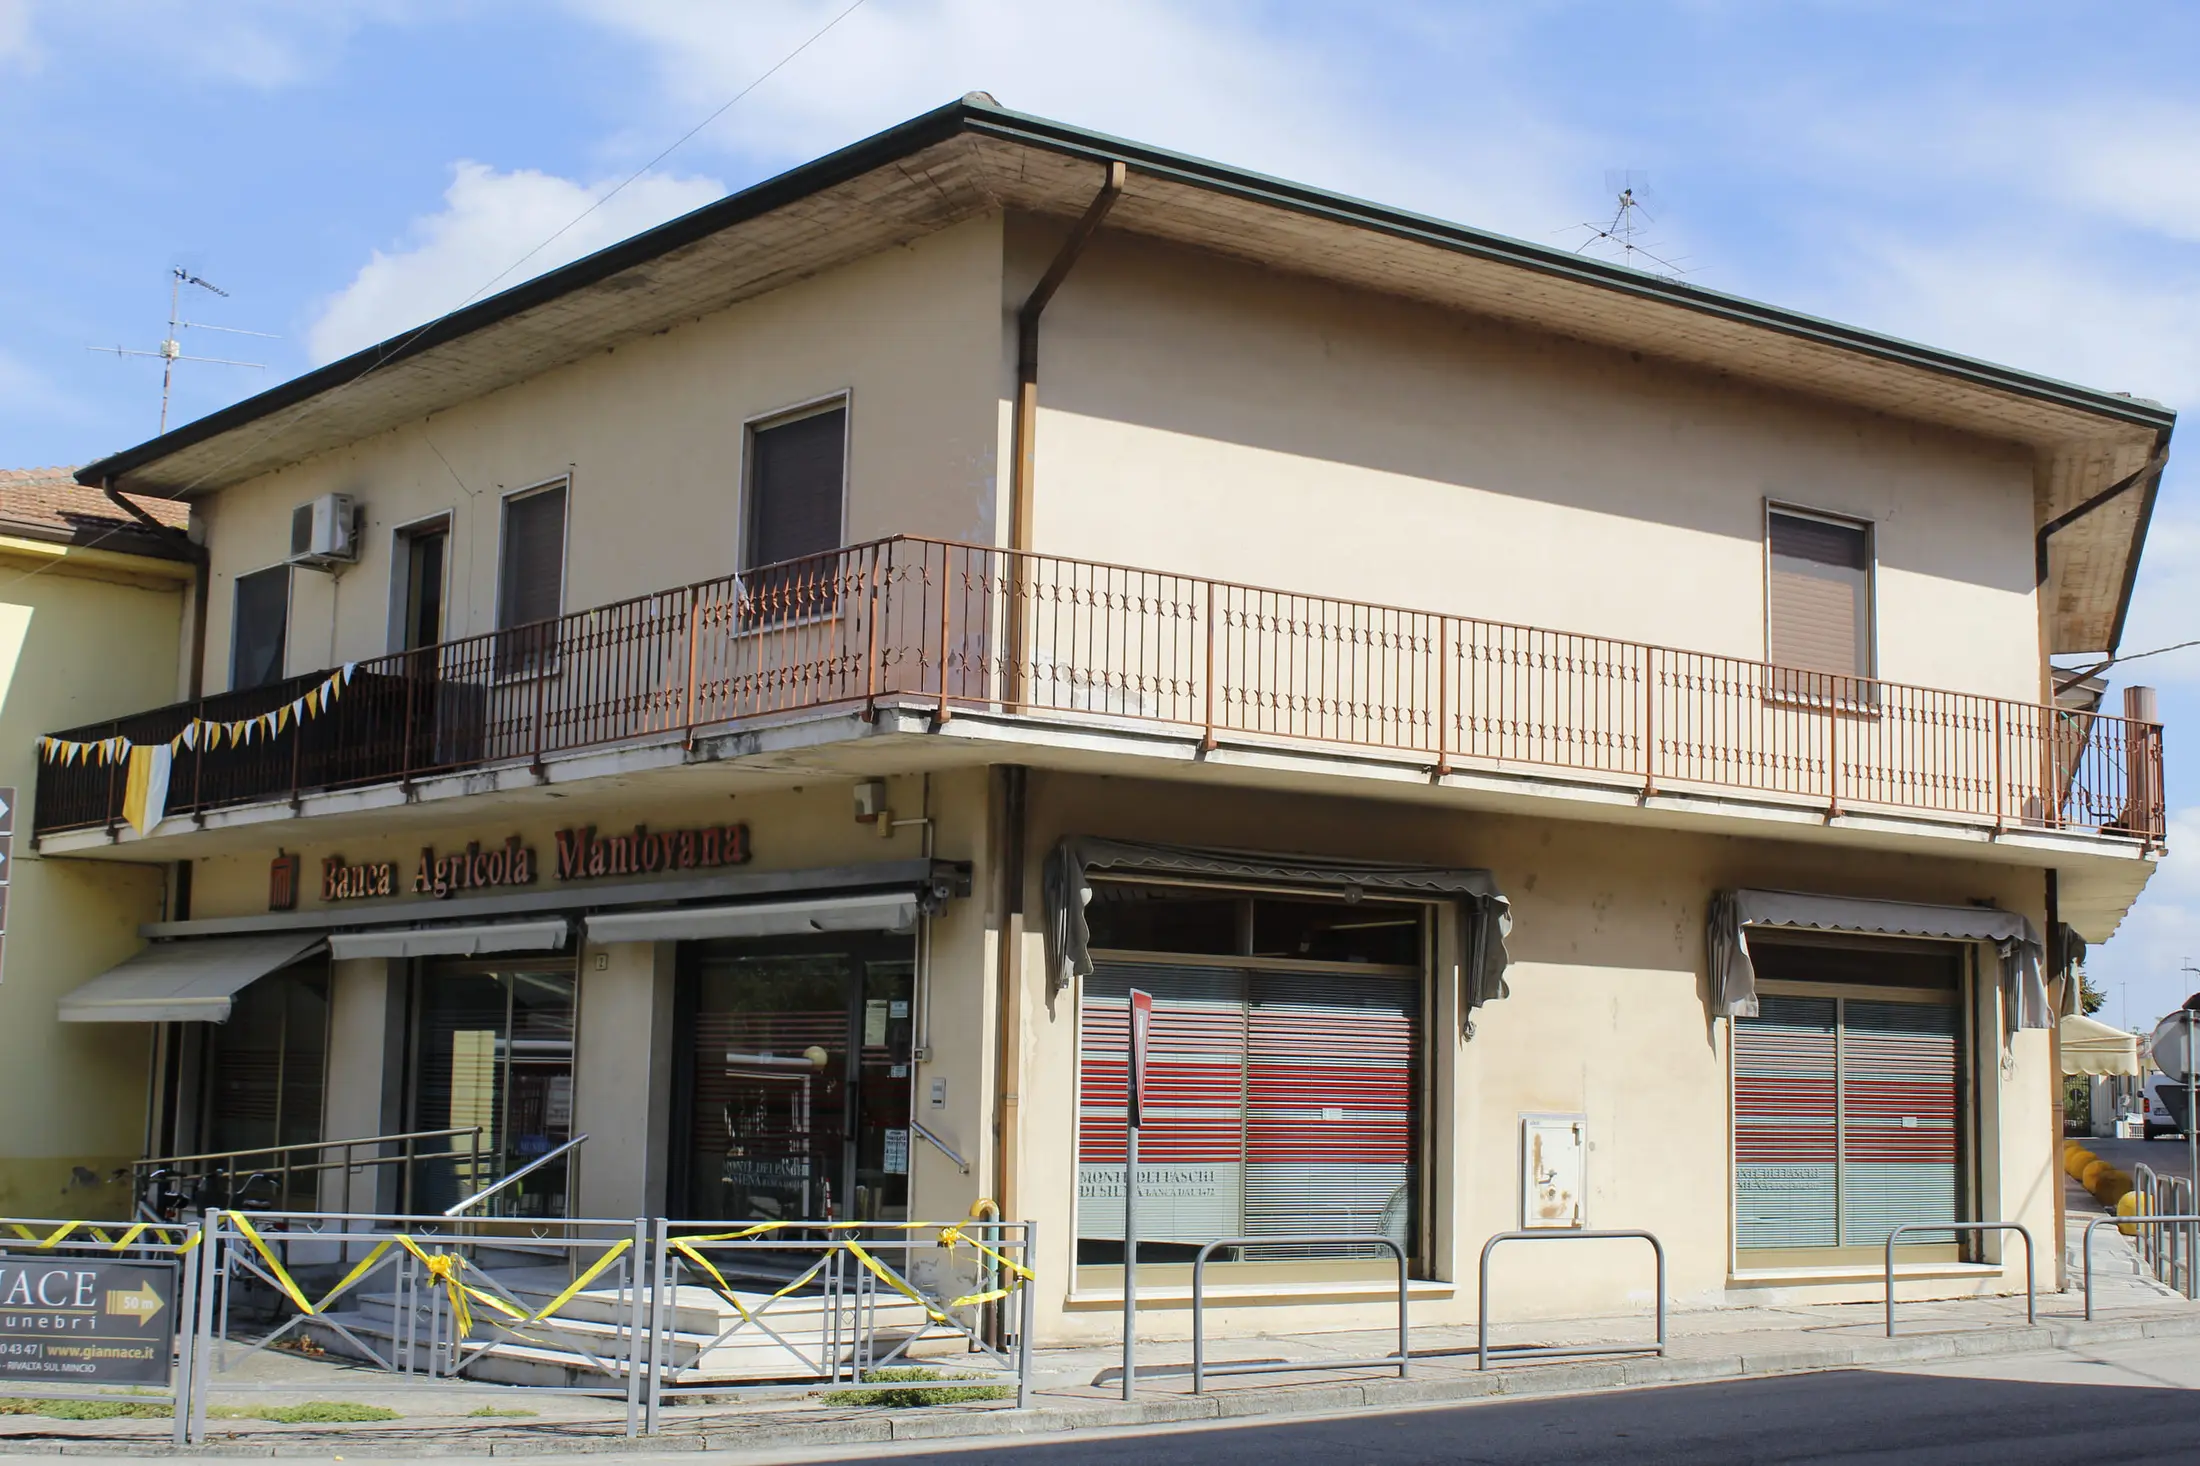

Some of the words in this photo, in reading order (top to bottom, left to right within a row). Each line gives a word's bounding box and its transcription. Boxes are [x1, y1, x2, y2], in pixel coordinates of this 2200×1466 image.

[322, 856, 396, 900] Banca
[411, 835, 535, 898] Agricola
[554, 823, 750, 880] Mantovana
[1099, 1185, 1143, 1197] SIEA
[124, 1296, 139, 1309] 50
[142, 1300, 154, 1309] m
[47, 1344, 155, 1360] www.giannace.it
[7, 1361, 42, 1371] RIVALTA
[43, 1362, 60, 1372] SUL
[61, 1363, 97, 1373] MINCIO
